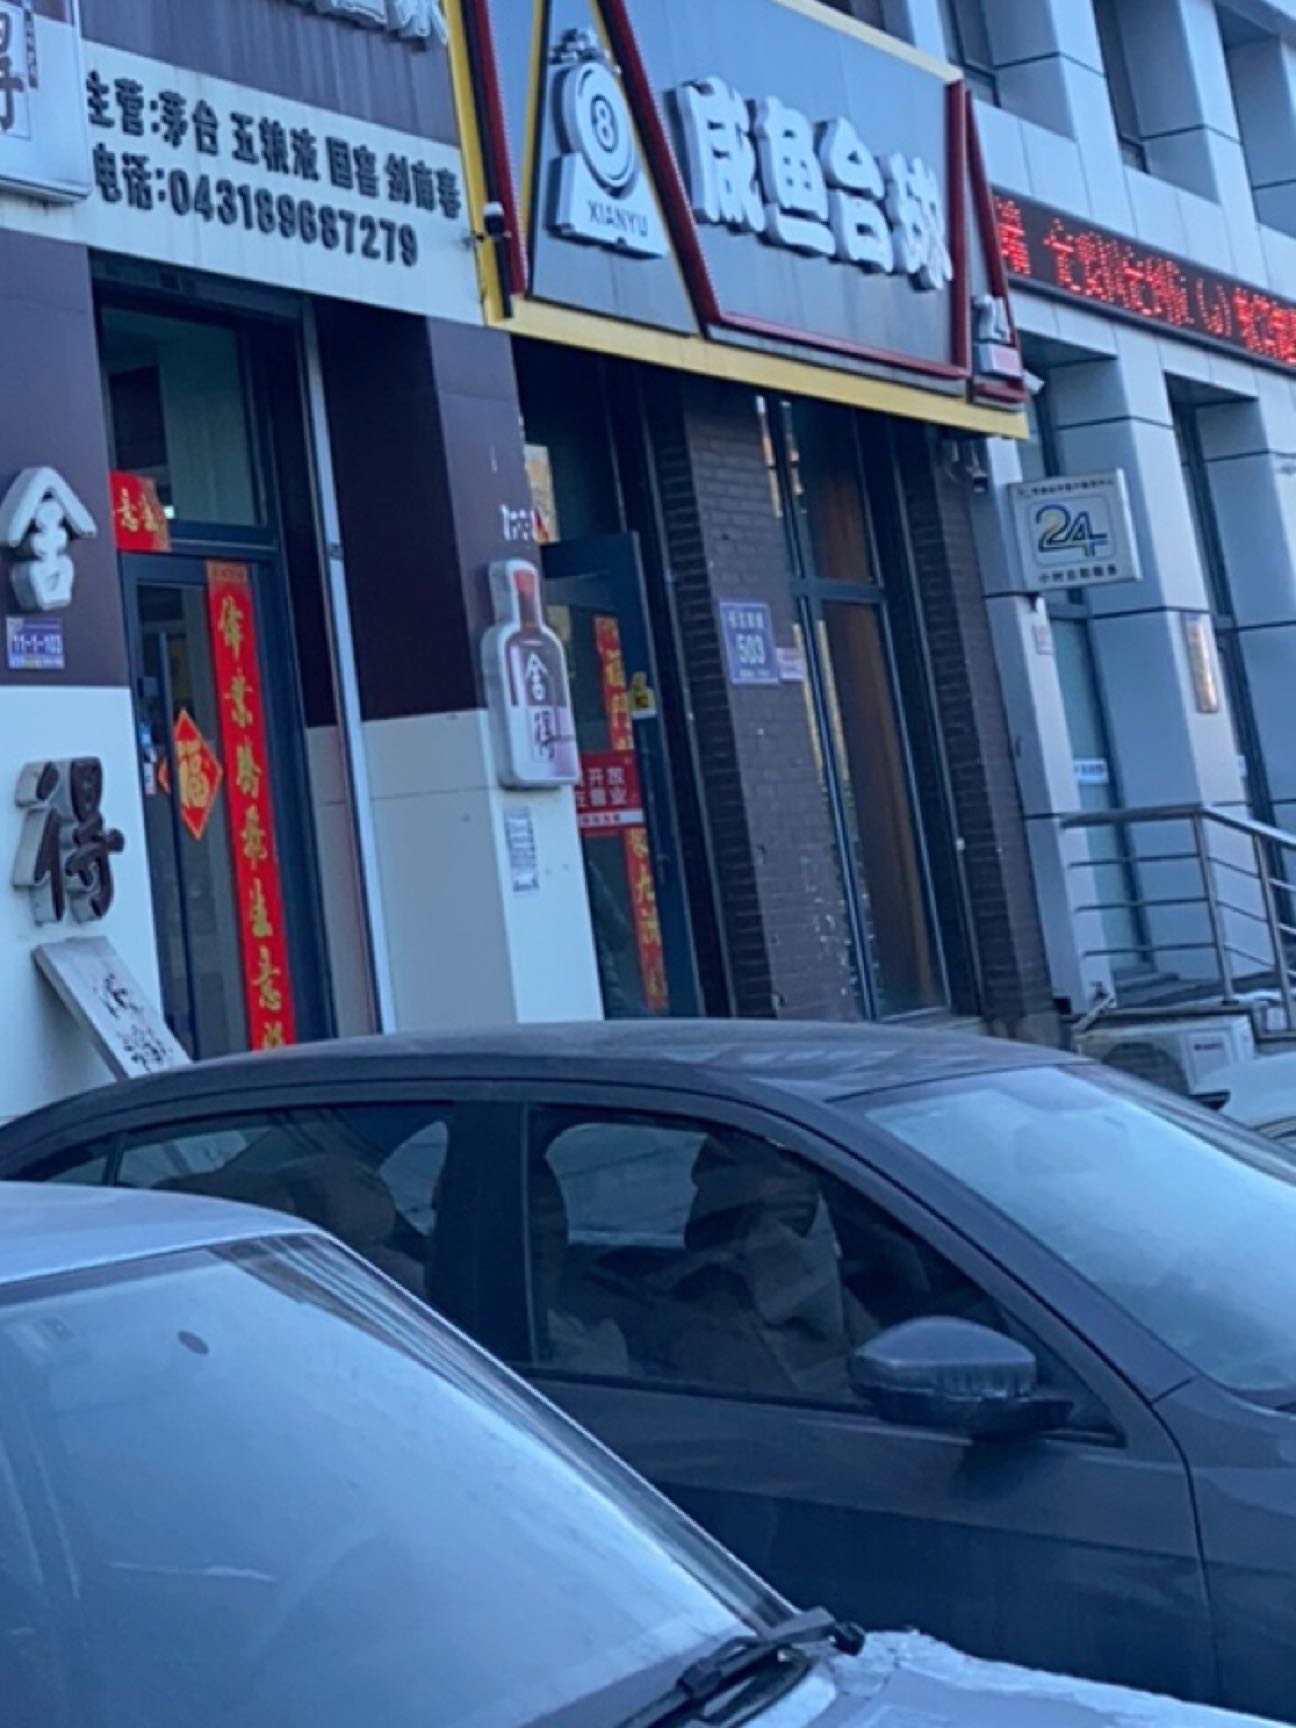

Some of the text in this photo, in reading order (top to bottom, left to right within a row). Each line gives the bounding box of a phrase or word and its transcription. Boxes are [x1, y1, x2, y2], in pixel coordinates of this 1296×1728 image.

[587, 197, 649, 238] XIANYU
[679, 75, 953, 292] 咸鱼台球
[1035, 503, 1108, 557] 24
[525, 652, 555, 761] 舍得
[175, 739, 210, 809] 福
[13, 756, 126, 925] 得
